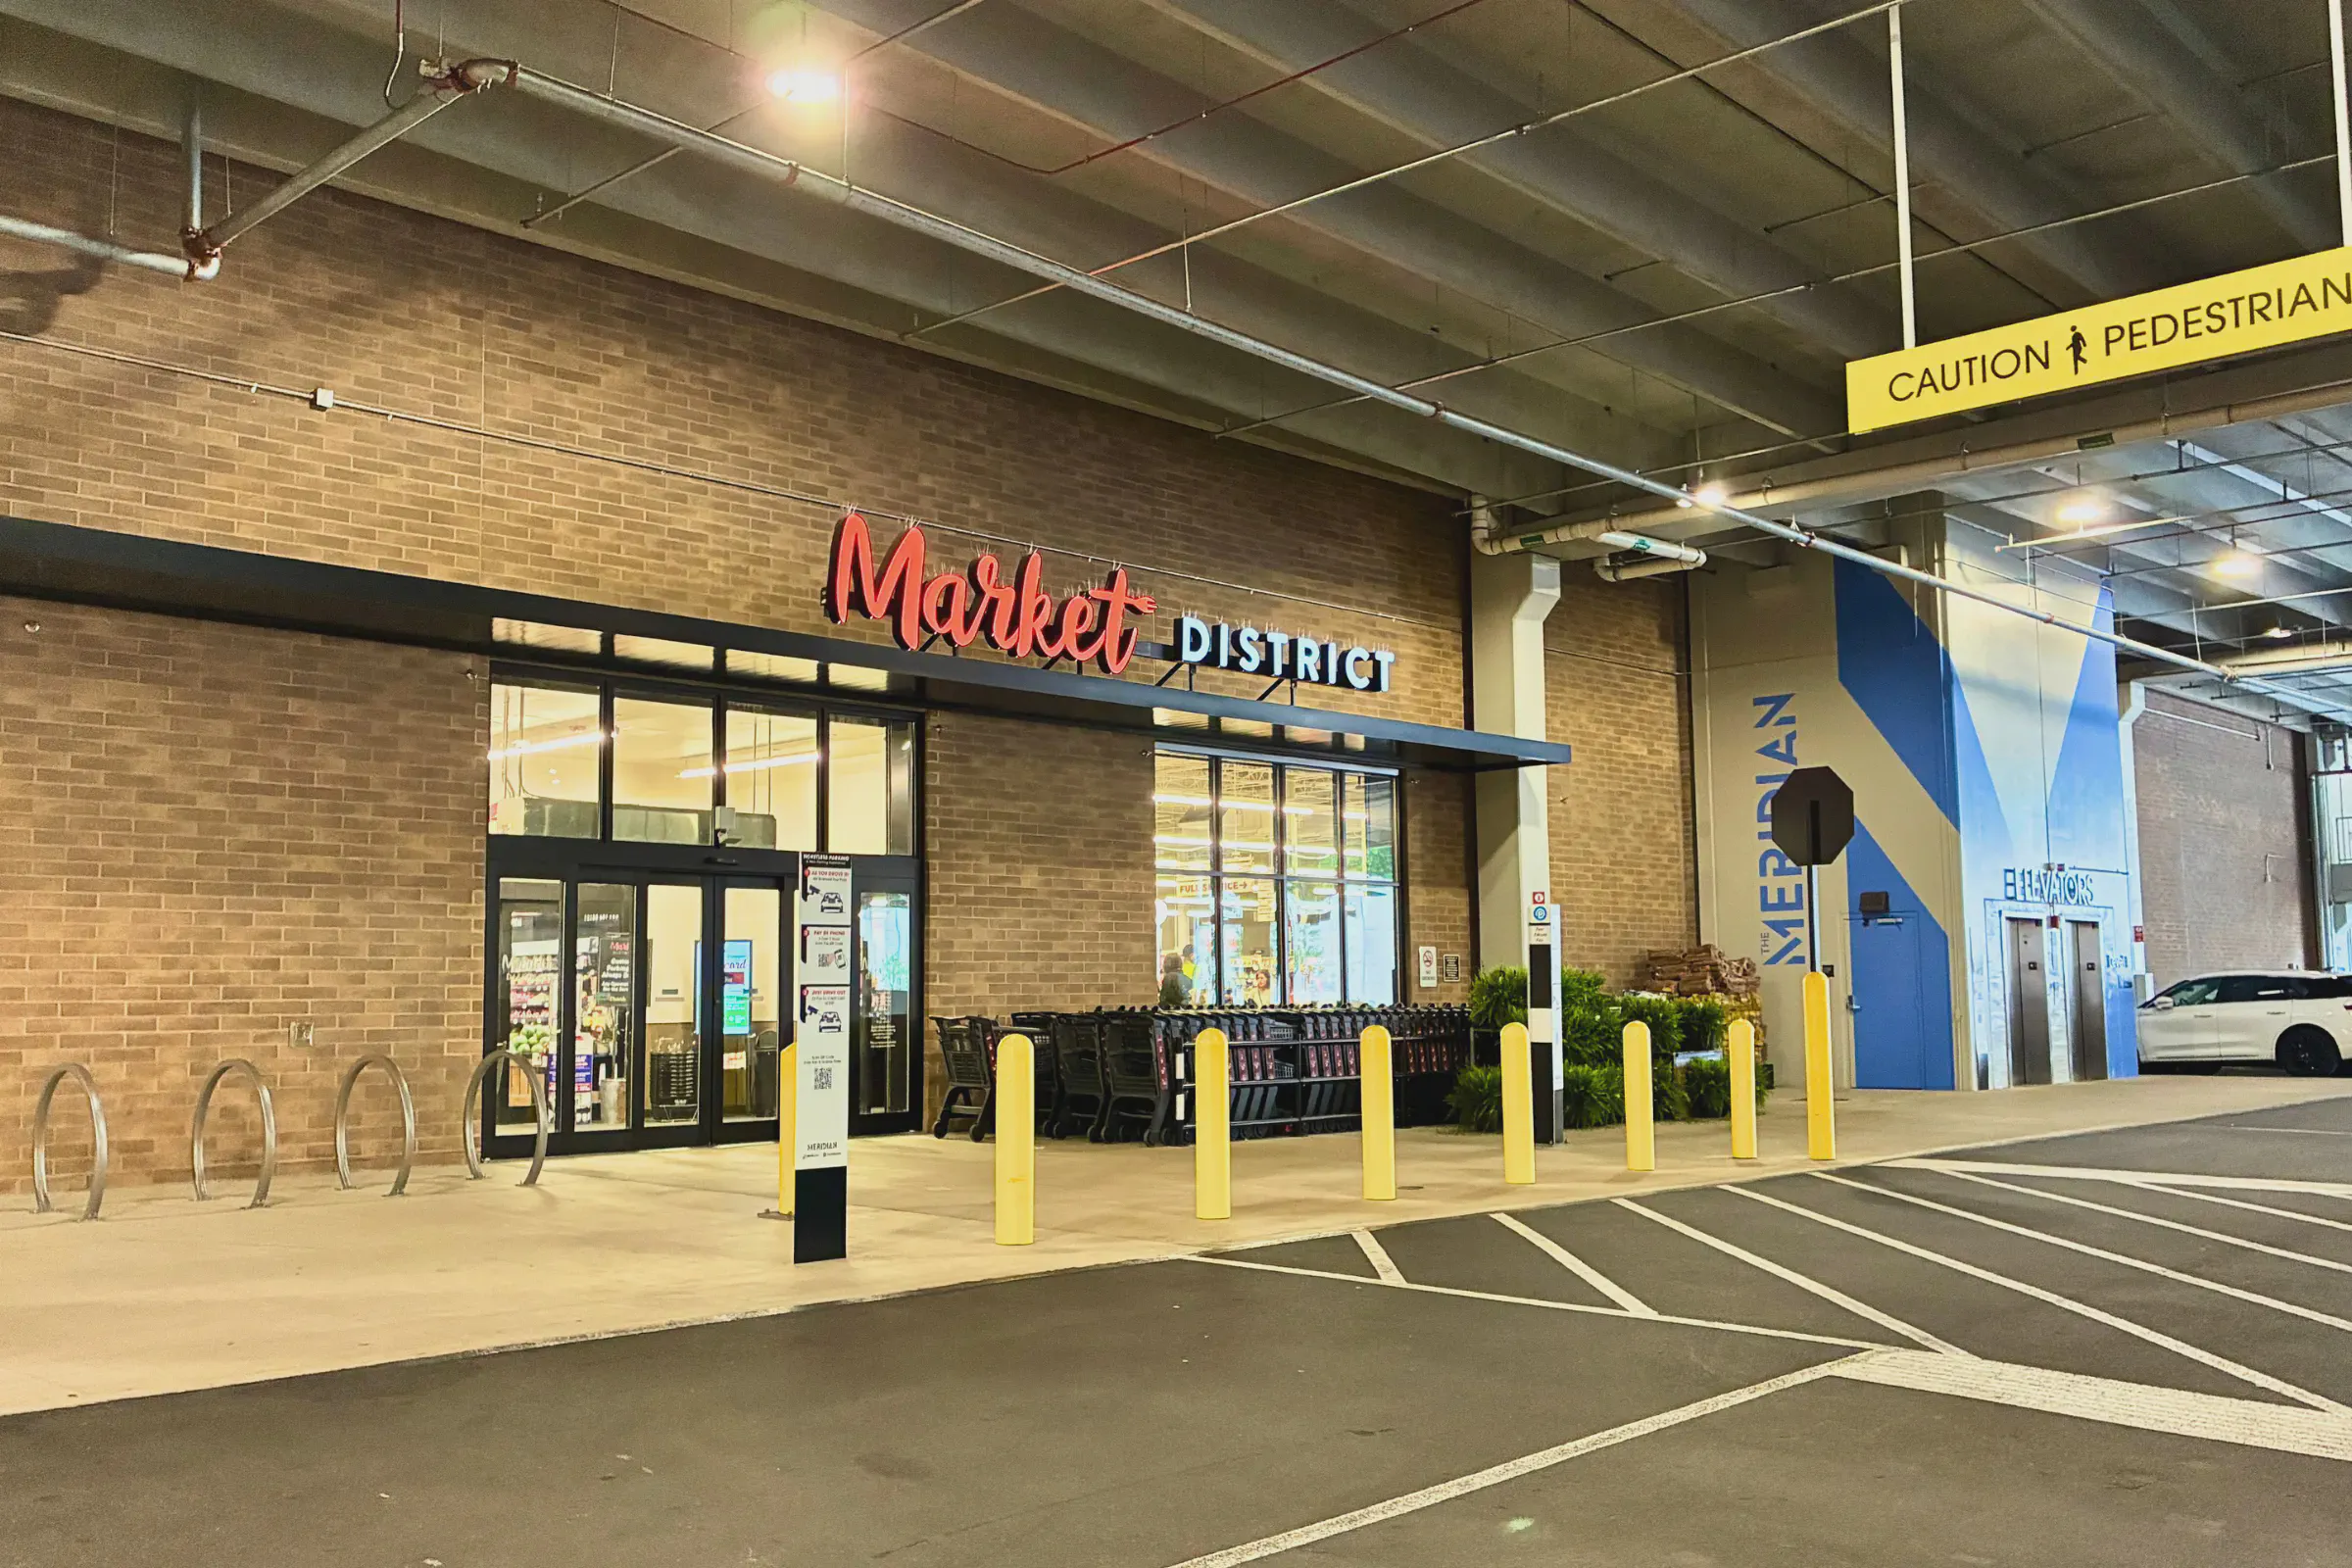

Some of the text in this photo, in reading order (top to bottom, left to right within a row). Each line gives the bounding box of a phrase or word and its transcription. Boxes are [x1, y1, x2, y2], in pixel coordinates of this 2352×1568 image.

[1888, 271, 2351, 402] CAUTION PEDESTRIAN
[829, 513, 1157, 674] Market
[1176, 617, 1396, 692] DISTRICT
[2003, 867, 2094, 906] ELEVATORS
[1760, 932, 1770, 955] THE
[807, 1141, 838, 1152] MERIDIAN
